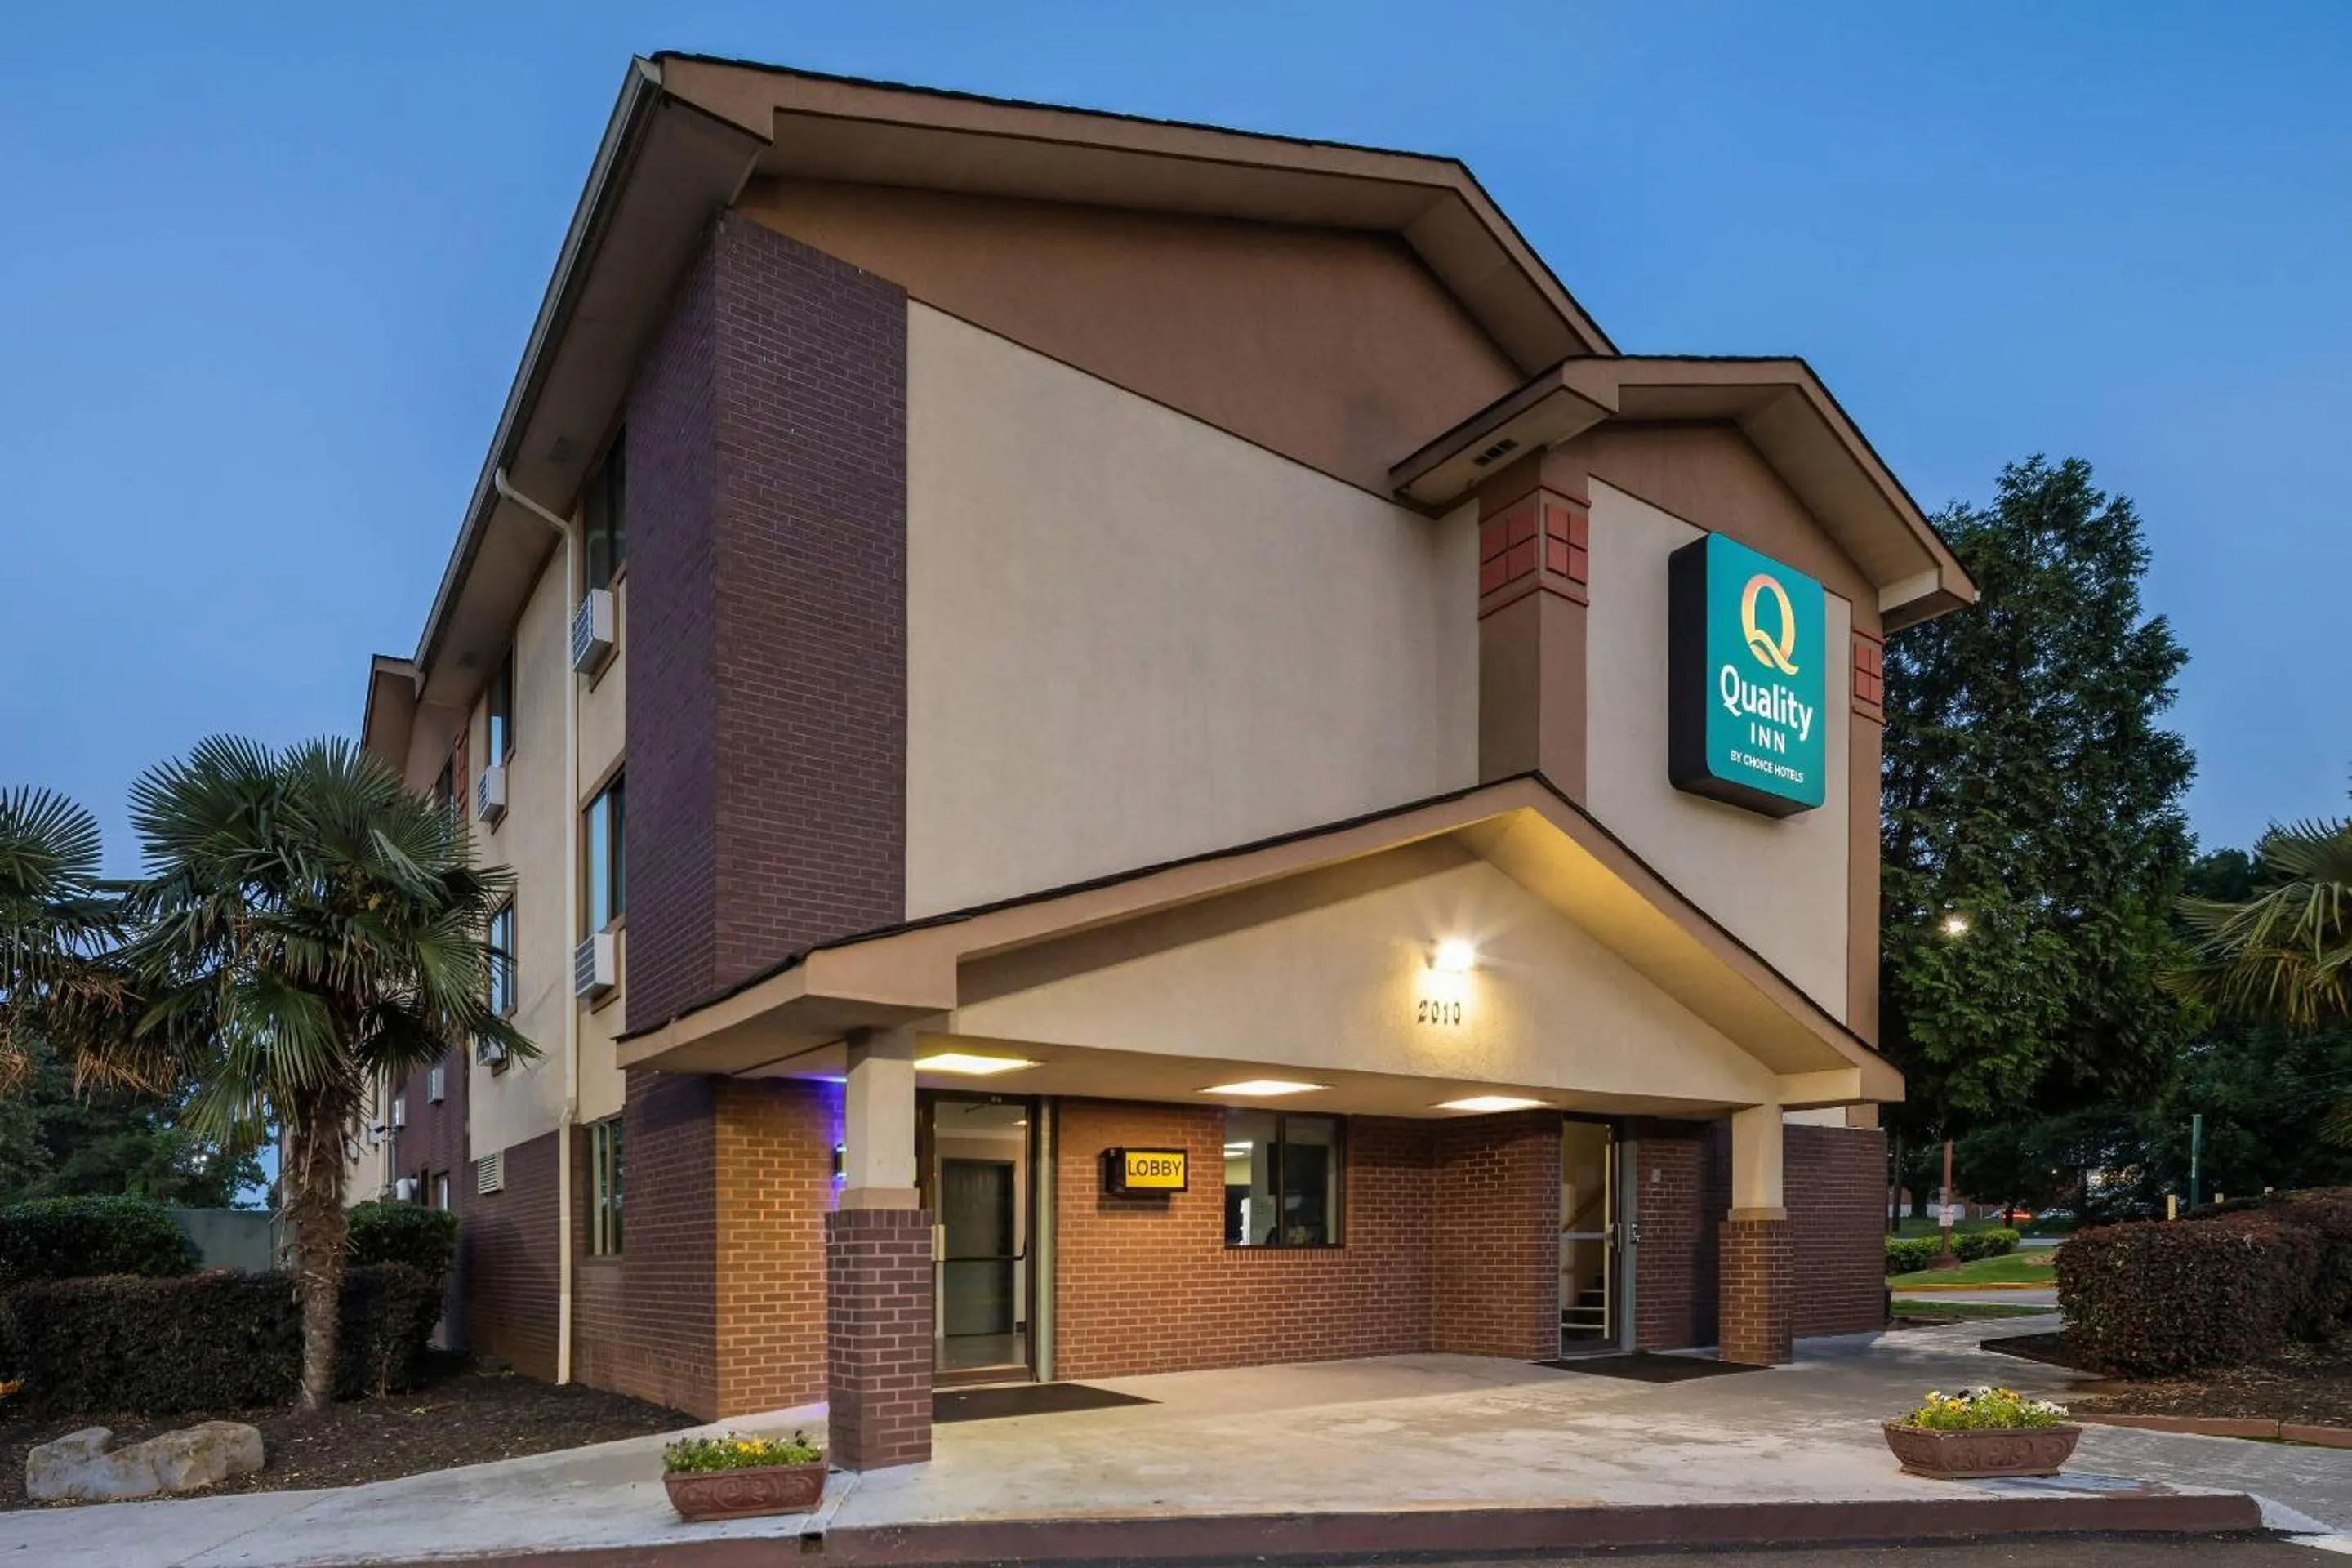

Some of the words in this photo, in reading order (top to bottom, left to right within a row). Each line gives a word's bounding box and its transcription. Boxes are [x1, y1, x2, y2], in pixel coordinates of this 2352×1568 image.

[1741, 573, 1799, 675] Q
[1720, 664, 1813, 742] Quality
[1750, 721, 1785, 754] INN
[1731, 749, 1743, 763] BY
[1743, 753, 1774, 774] CHOICE
[1774, 764, 1804, 784] HOTELS
[1417, 999, 1461, 1026] 2010
[1127, 1160, 1182, 1177] LOBBY
